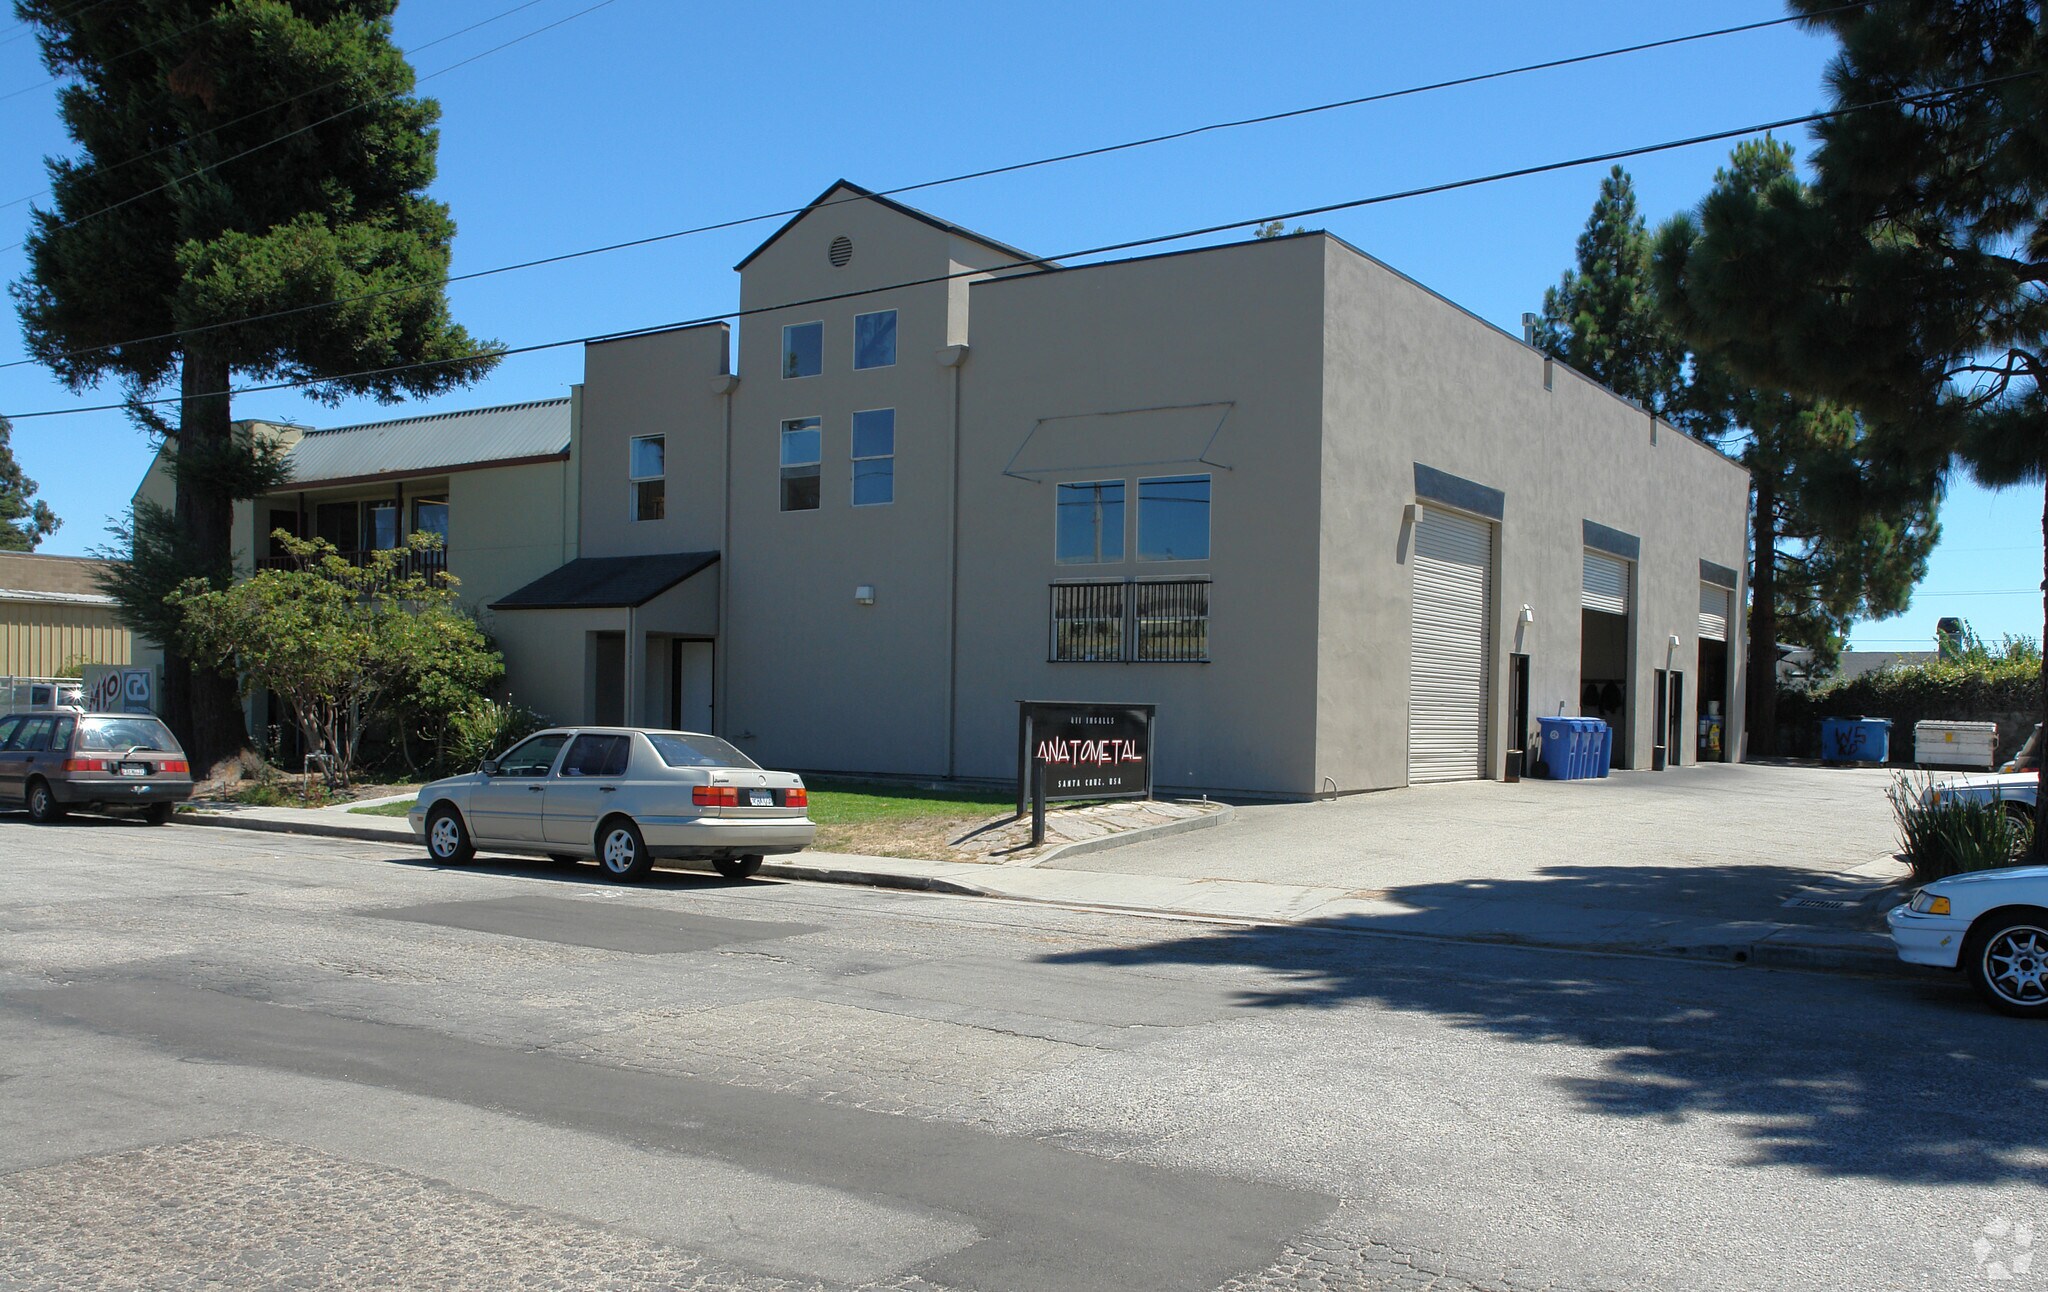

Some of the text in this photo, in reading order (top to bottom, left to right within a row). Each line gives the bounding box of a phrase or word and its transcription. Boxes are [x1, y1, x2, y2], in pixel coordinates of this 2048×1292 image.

[1086, 716, 1115, 725] INGALLS
[1036, 735, 1143, 768] ANATOMETAL
[1057, 779, 1081, 788] SANTA
[1108, 777, 1122, 786] USA
